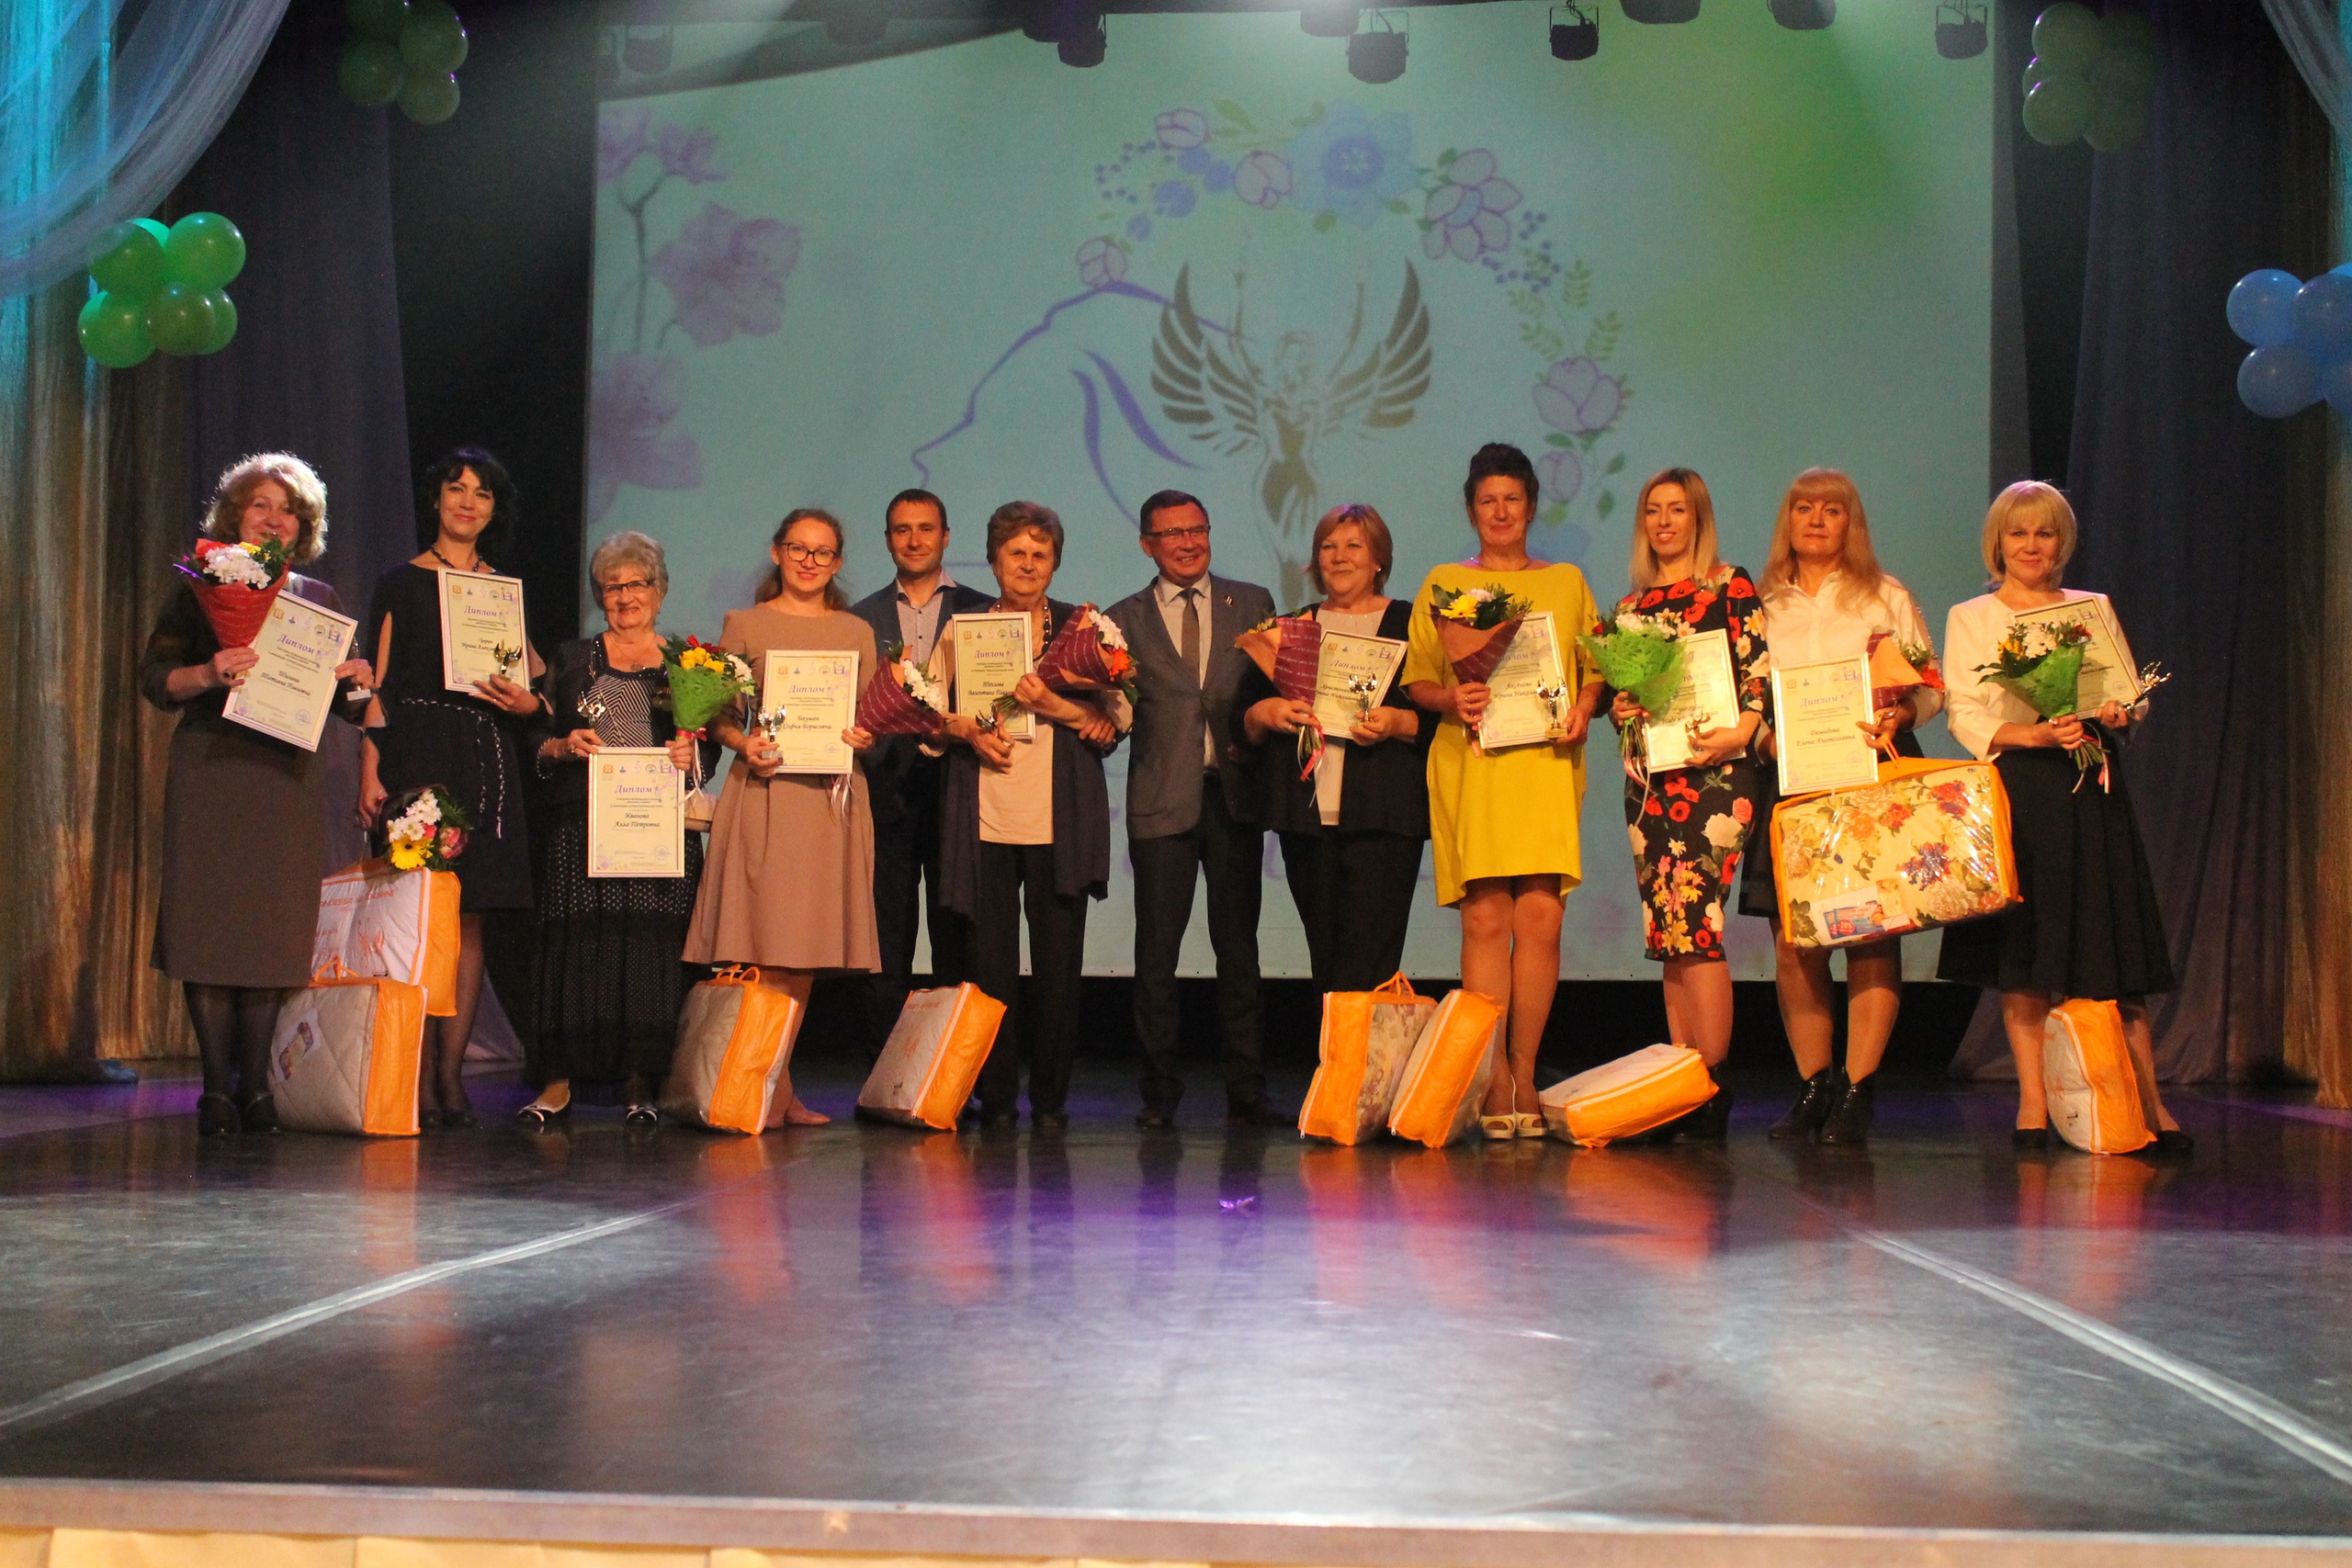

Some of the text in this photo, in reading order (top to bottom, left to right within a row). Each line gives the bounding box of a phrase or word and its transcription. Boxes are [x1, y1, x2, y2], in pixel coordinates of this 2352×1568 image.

[463, 605, 497, 616] Диплом
[277, 634, 315, 655] Диплом
[974, 649, 1005, 660] Диплом
[1330, 660, 1366, 671] Диплом
[788, 685, 825, 694] Диплом
[1800, 696, 1838, 707] Диплом
[615, 784, 652, 794] Диплом
[630, 821, 661, 829] Петровна
